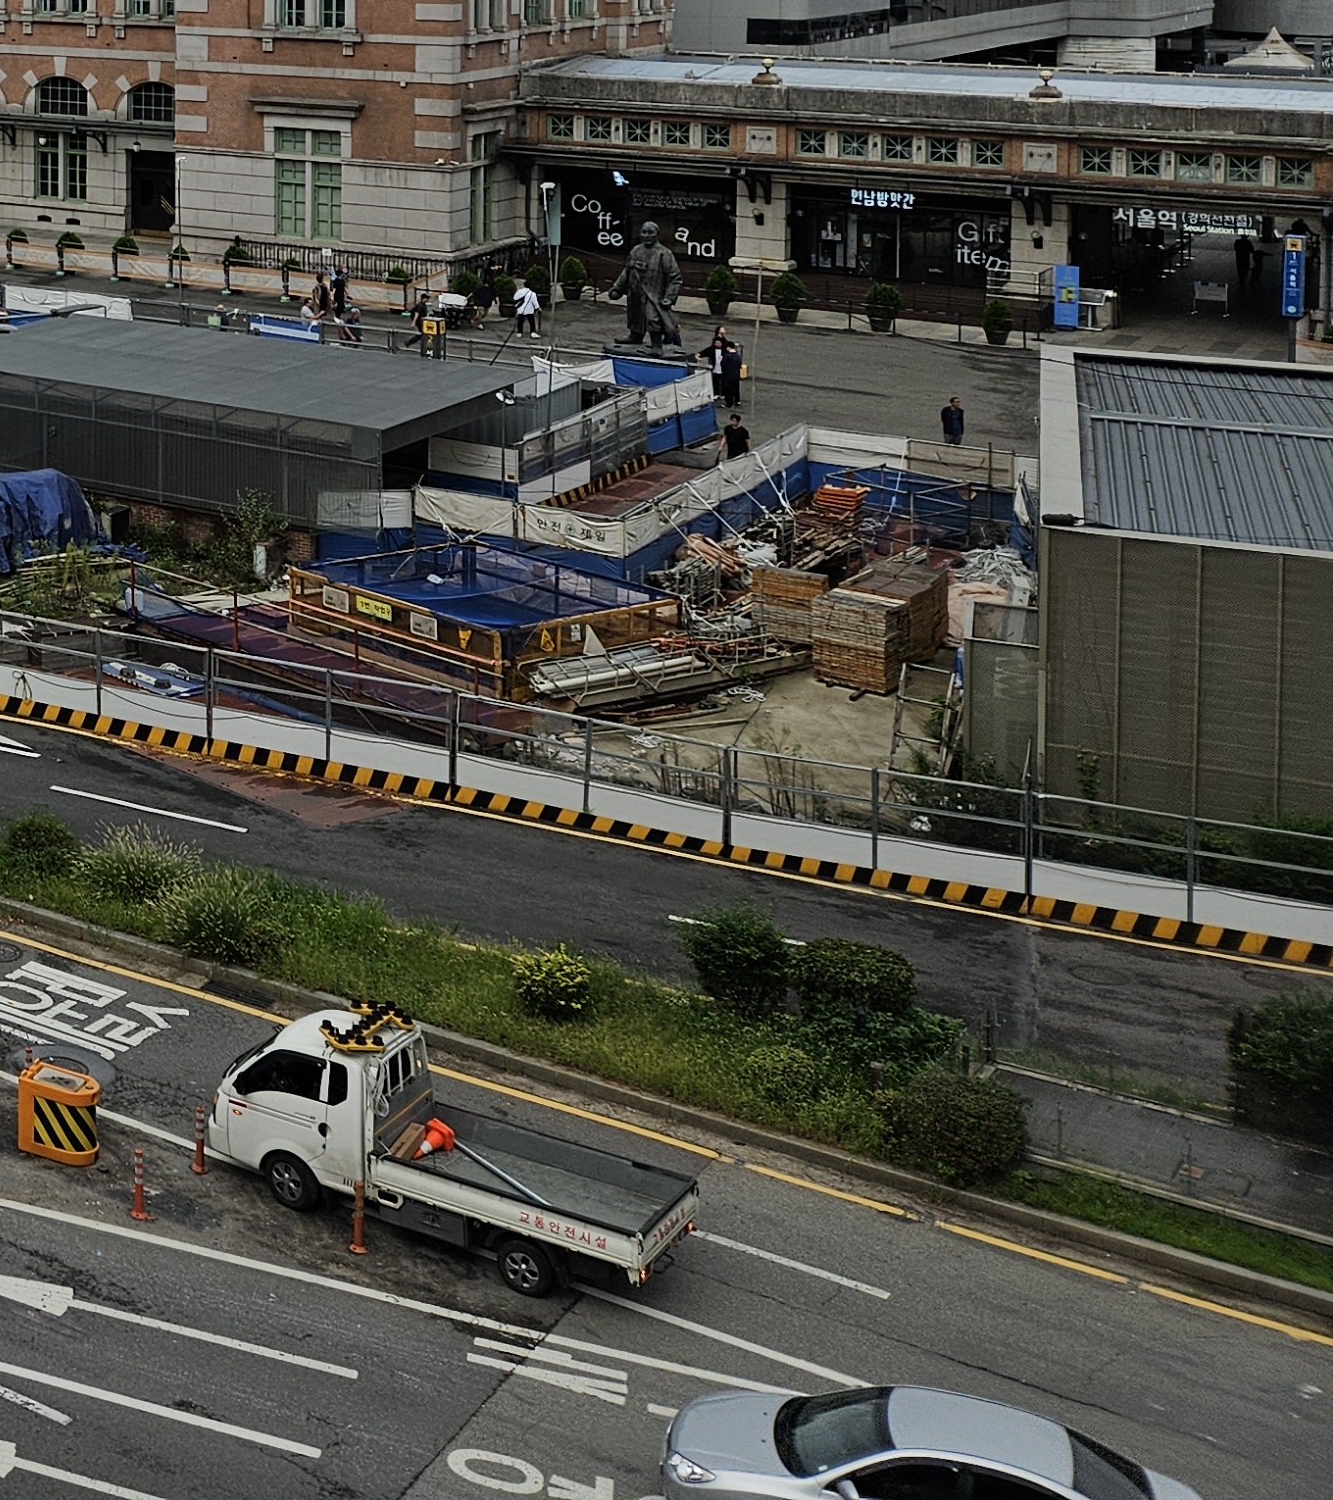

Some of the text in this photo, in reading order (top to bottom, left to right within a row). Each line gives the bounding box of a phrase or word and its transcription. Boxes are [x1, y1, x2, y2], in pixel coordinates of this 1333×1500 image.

[1113, 207, 1177, 231] 서울역
[1183, 224, 1206, 234] Seoul
[1206, 225, 1235, 235] Station
[536, 518, 606, 543] 안전 제일
[518, 1210, 608, 1251] 교통안전시설
